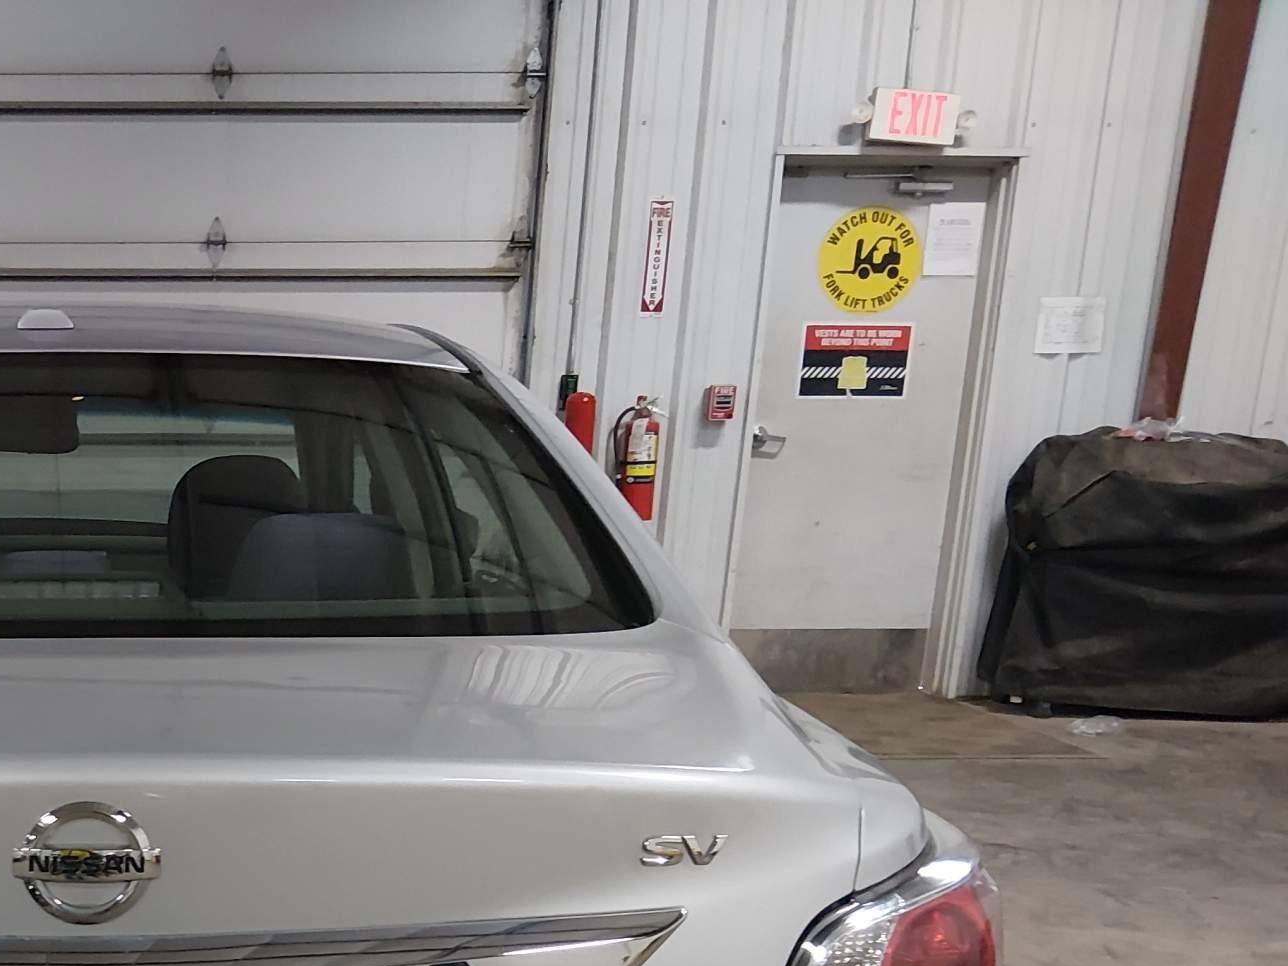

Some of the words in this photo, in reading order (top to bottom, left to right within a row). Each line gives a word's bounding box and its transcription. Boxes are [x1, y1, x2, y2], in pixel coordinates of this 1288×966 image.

[888, 91, 948, 137] EXIT
[652, 207, 671, 218] FIRE
[827, 212, 867, 246] WATCH
[871, 211, 896, 226] OUT
[895, 222, 915, 248] FOR
[648, 220, 664, 306] EXTINGUISHER
[823, 273, 845, 302] FORK
[843, 295, 867, 310] LIFT
[870, 276, 909, 309] TRUCKS
[28, 854, 145, 874] NISSAN
[640, 834, 729, 867] SV
